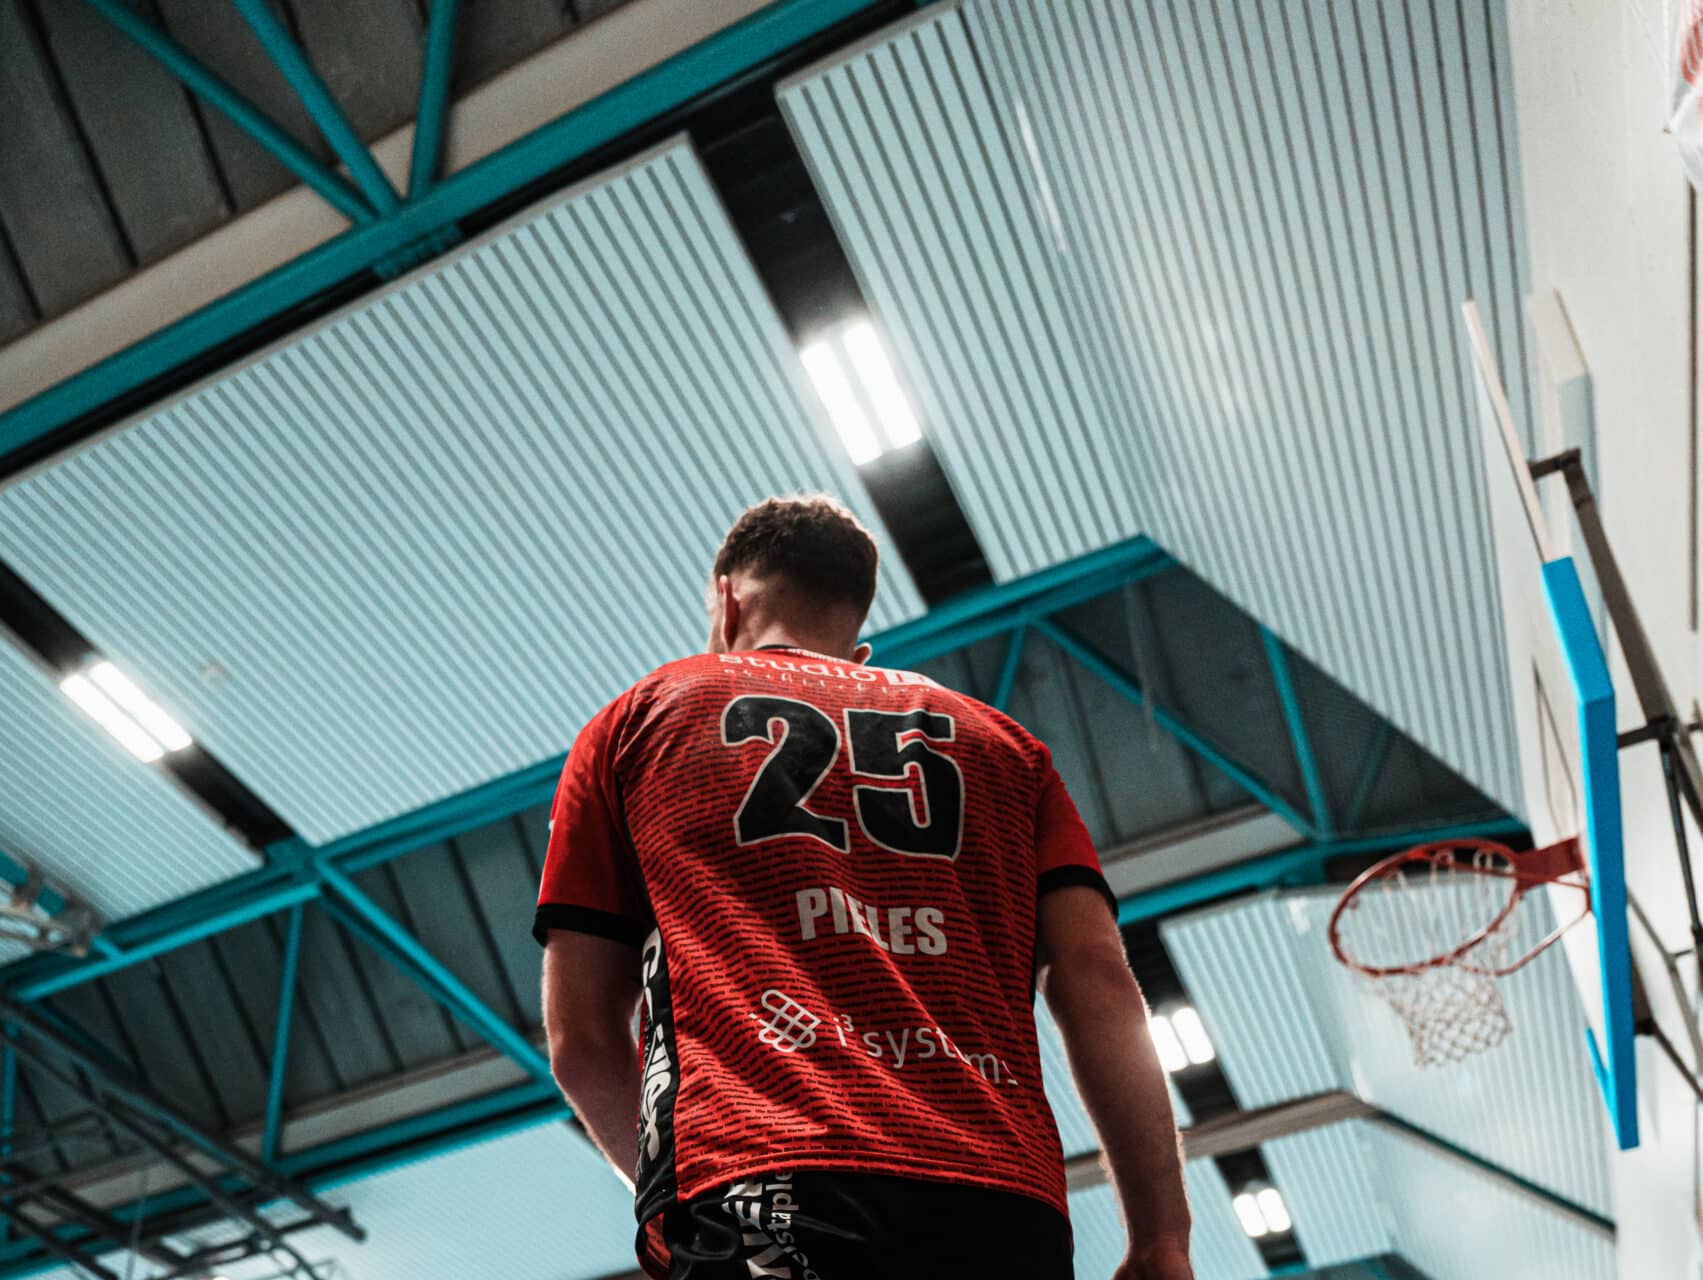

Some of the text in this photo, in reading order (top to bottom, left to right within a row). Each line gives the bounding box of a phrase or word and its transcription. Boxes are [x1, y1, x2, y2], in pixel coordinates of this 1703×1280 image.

[718, 653, 877, 683] studio
[720, 694, 966, 862] 25
[795, 886, 948, 956] PIELES
